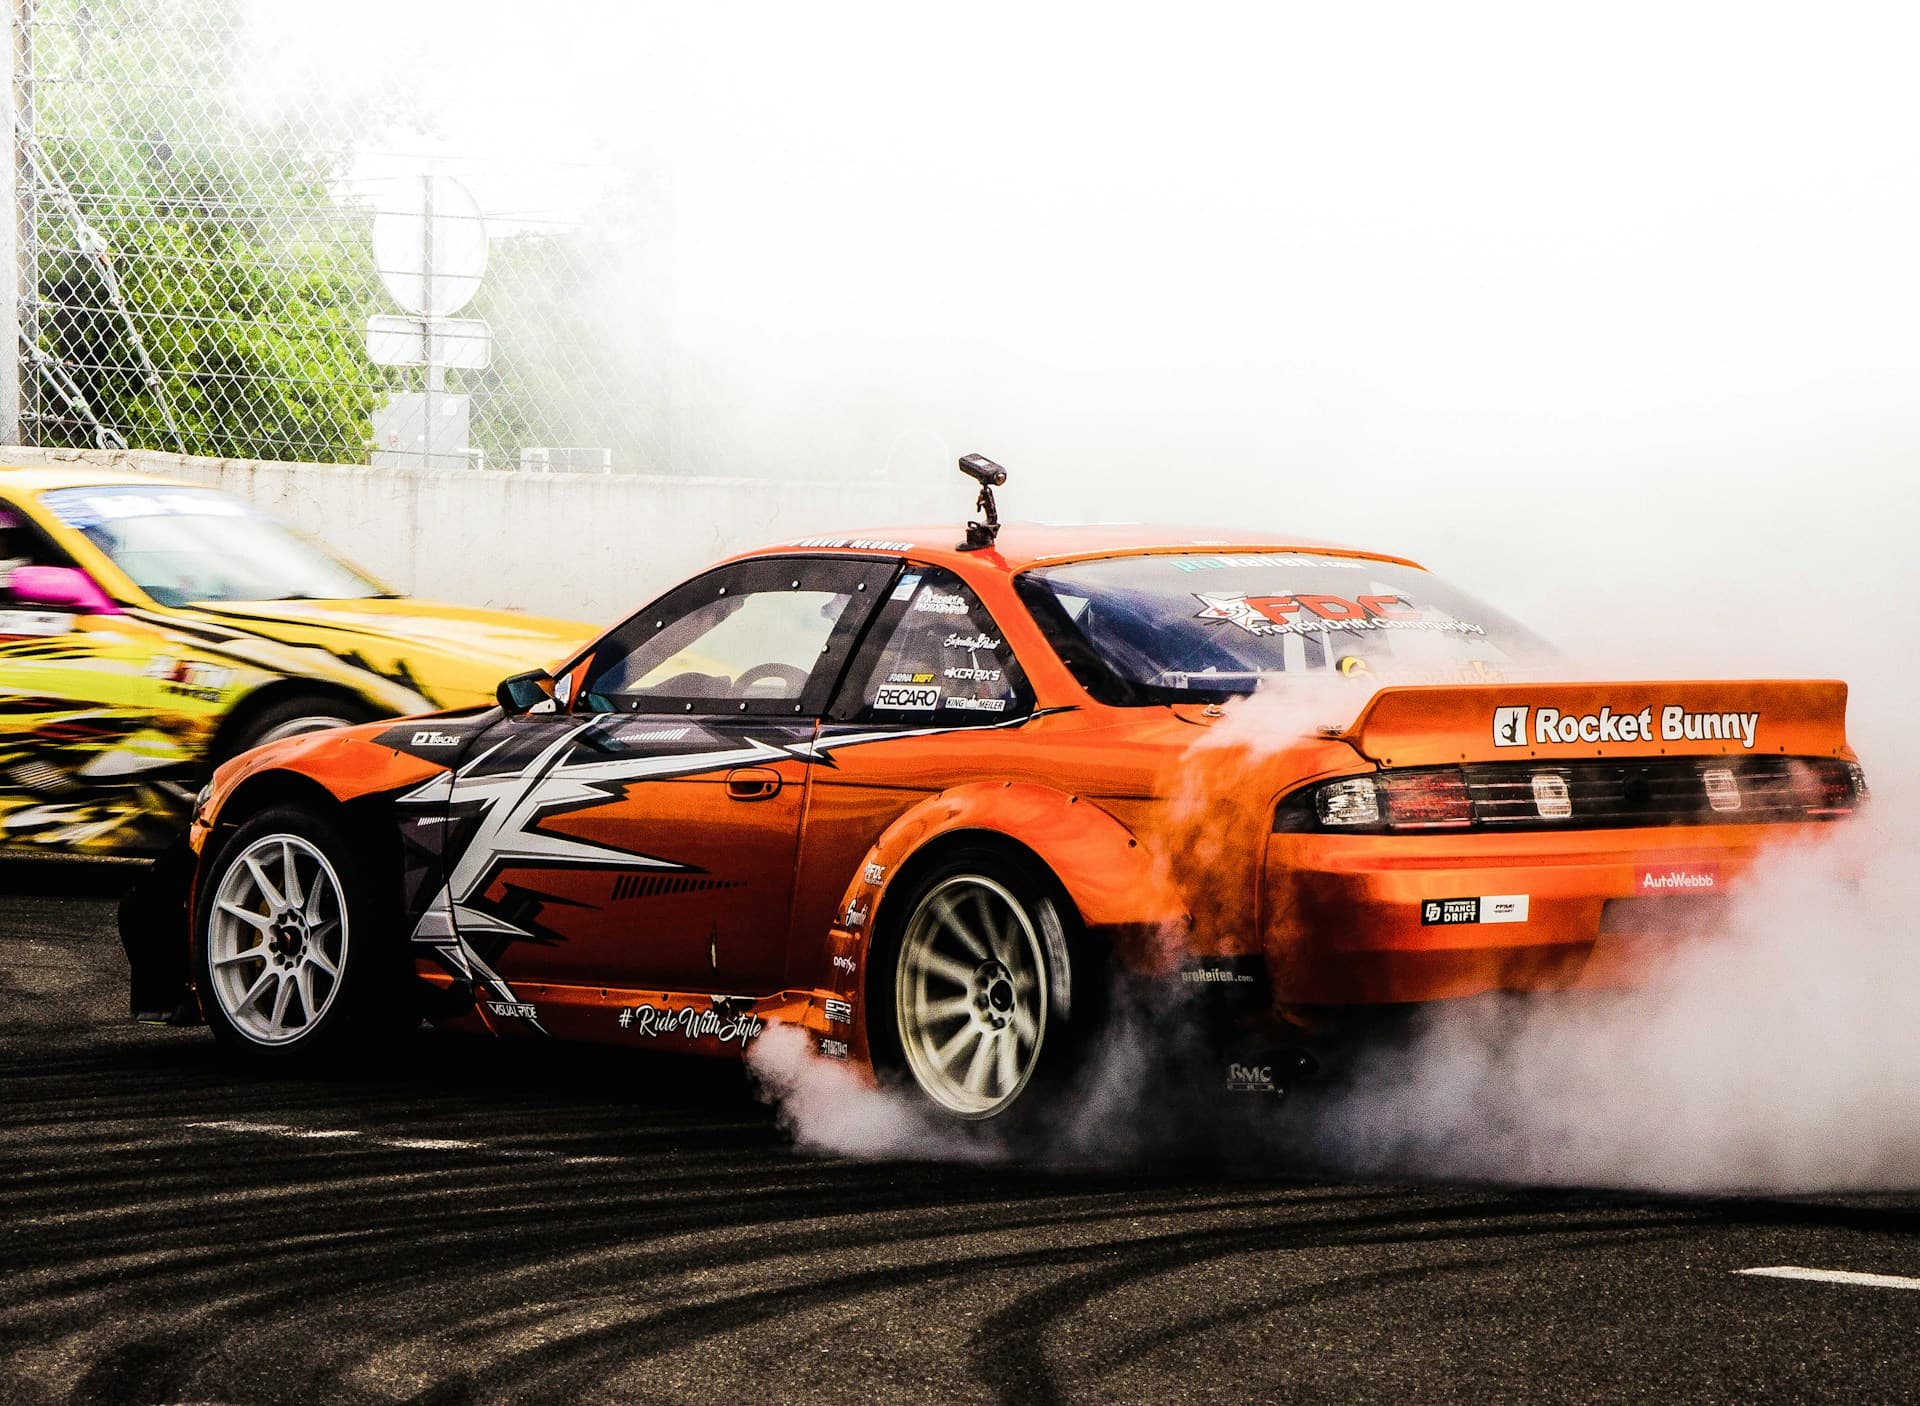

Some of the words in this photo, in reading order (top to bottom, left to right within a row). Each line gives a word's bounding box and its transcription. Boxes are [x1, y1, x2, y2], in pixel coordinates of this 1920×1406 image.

[1246, 595, 1421, 625] FDC
[1248, 619, 1324, 636] French
[1320, 618, 1374, 631] Drift
[1371, 618, 1486, 635] Community
[876, 689, 937, 706] RECARO
[946, 698, 965, 707] KING
[1536, 706, 1652, 743] Rocket
[1661, 705, 1759, 748] Bunny
[1643, 872, 1713, 888] AutoWebbb
[1444, 904, 1476, 912] FRANCE
[1444, 911, 1477, 922] DRIFT
[1181, 968, 1254, 983] proReifen.com
